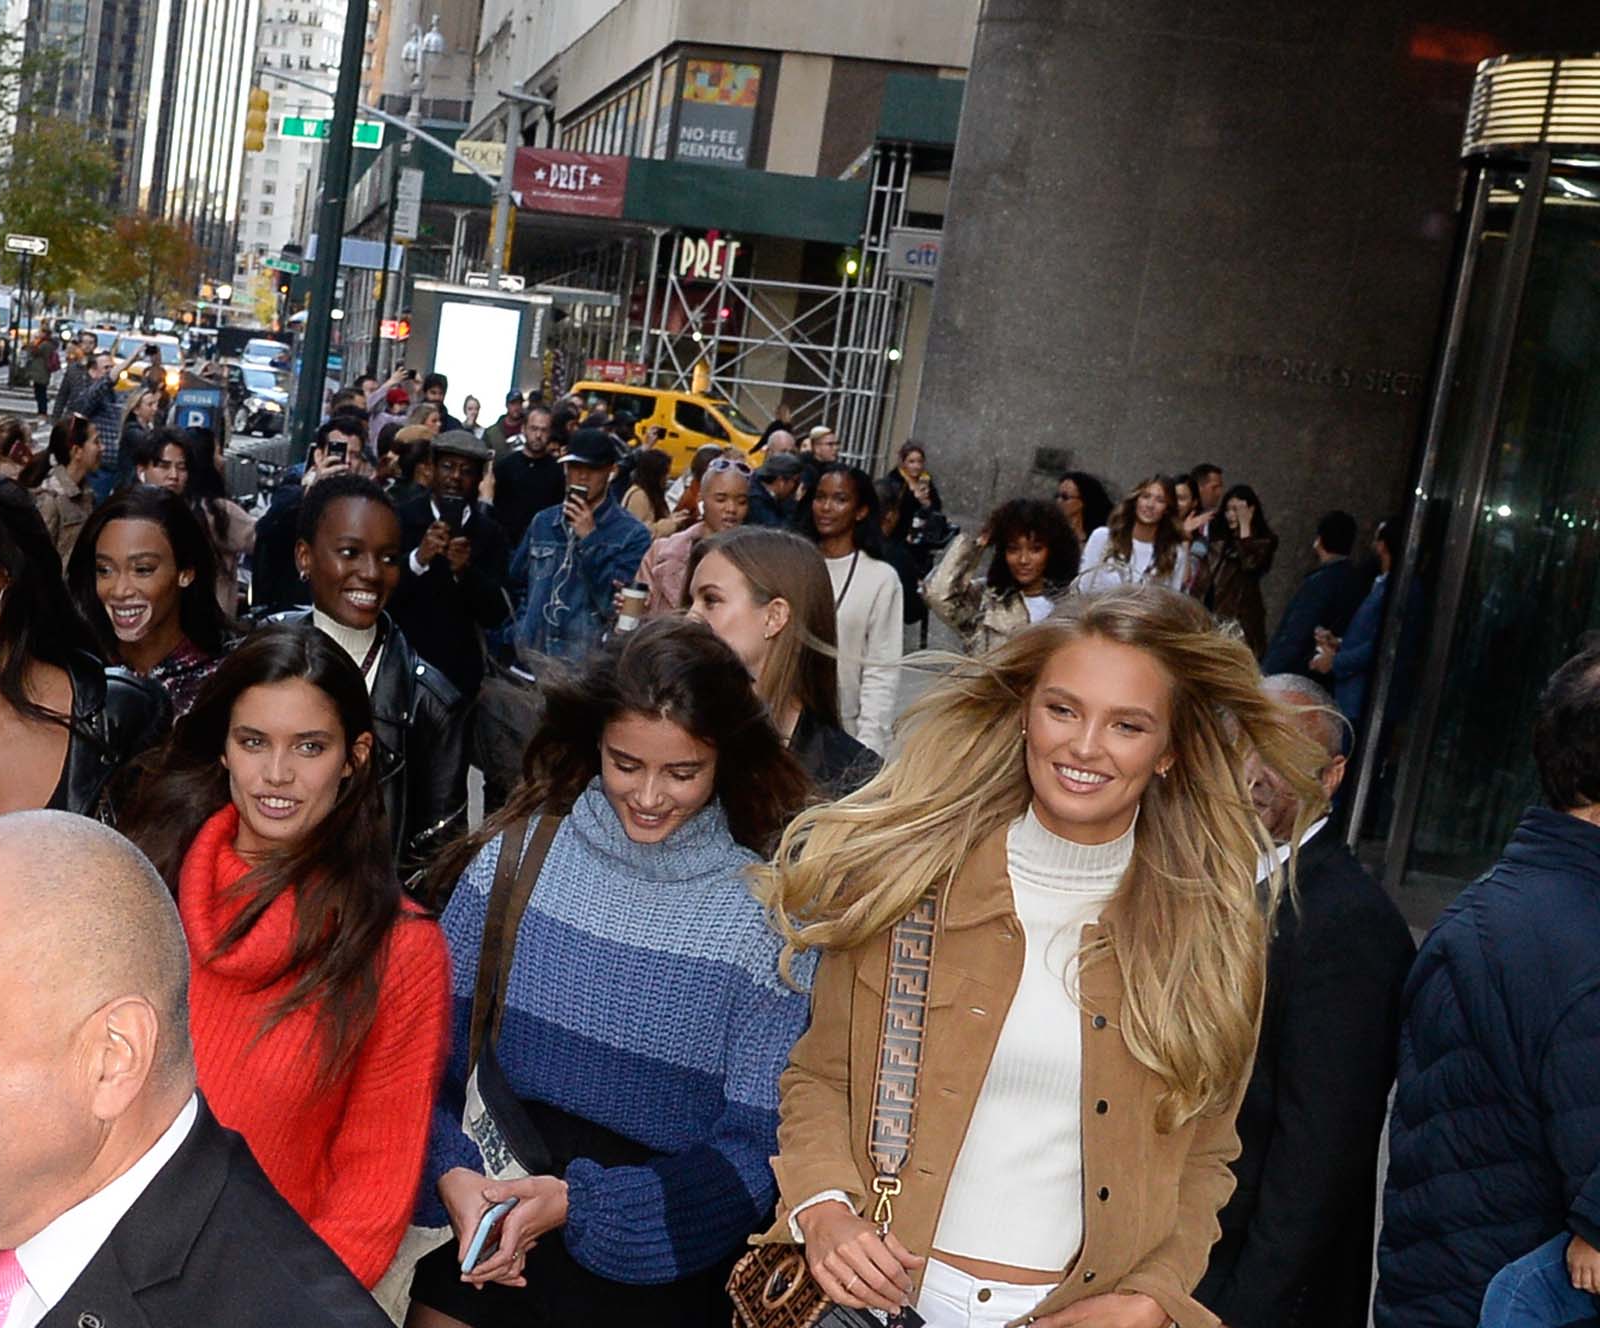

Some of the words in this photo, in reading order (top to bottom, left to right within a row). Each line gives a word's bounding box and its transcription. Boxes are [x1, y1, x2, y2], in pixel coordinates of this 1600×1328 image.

[302, 120, 318, 137] W
[680, 126, 738, 144] NO-FEE
[678, 141, 745, 162] RENTALS
[549, 163, 588, 190] PRET
[679, 236, 741, 280] PRET
